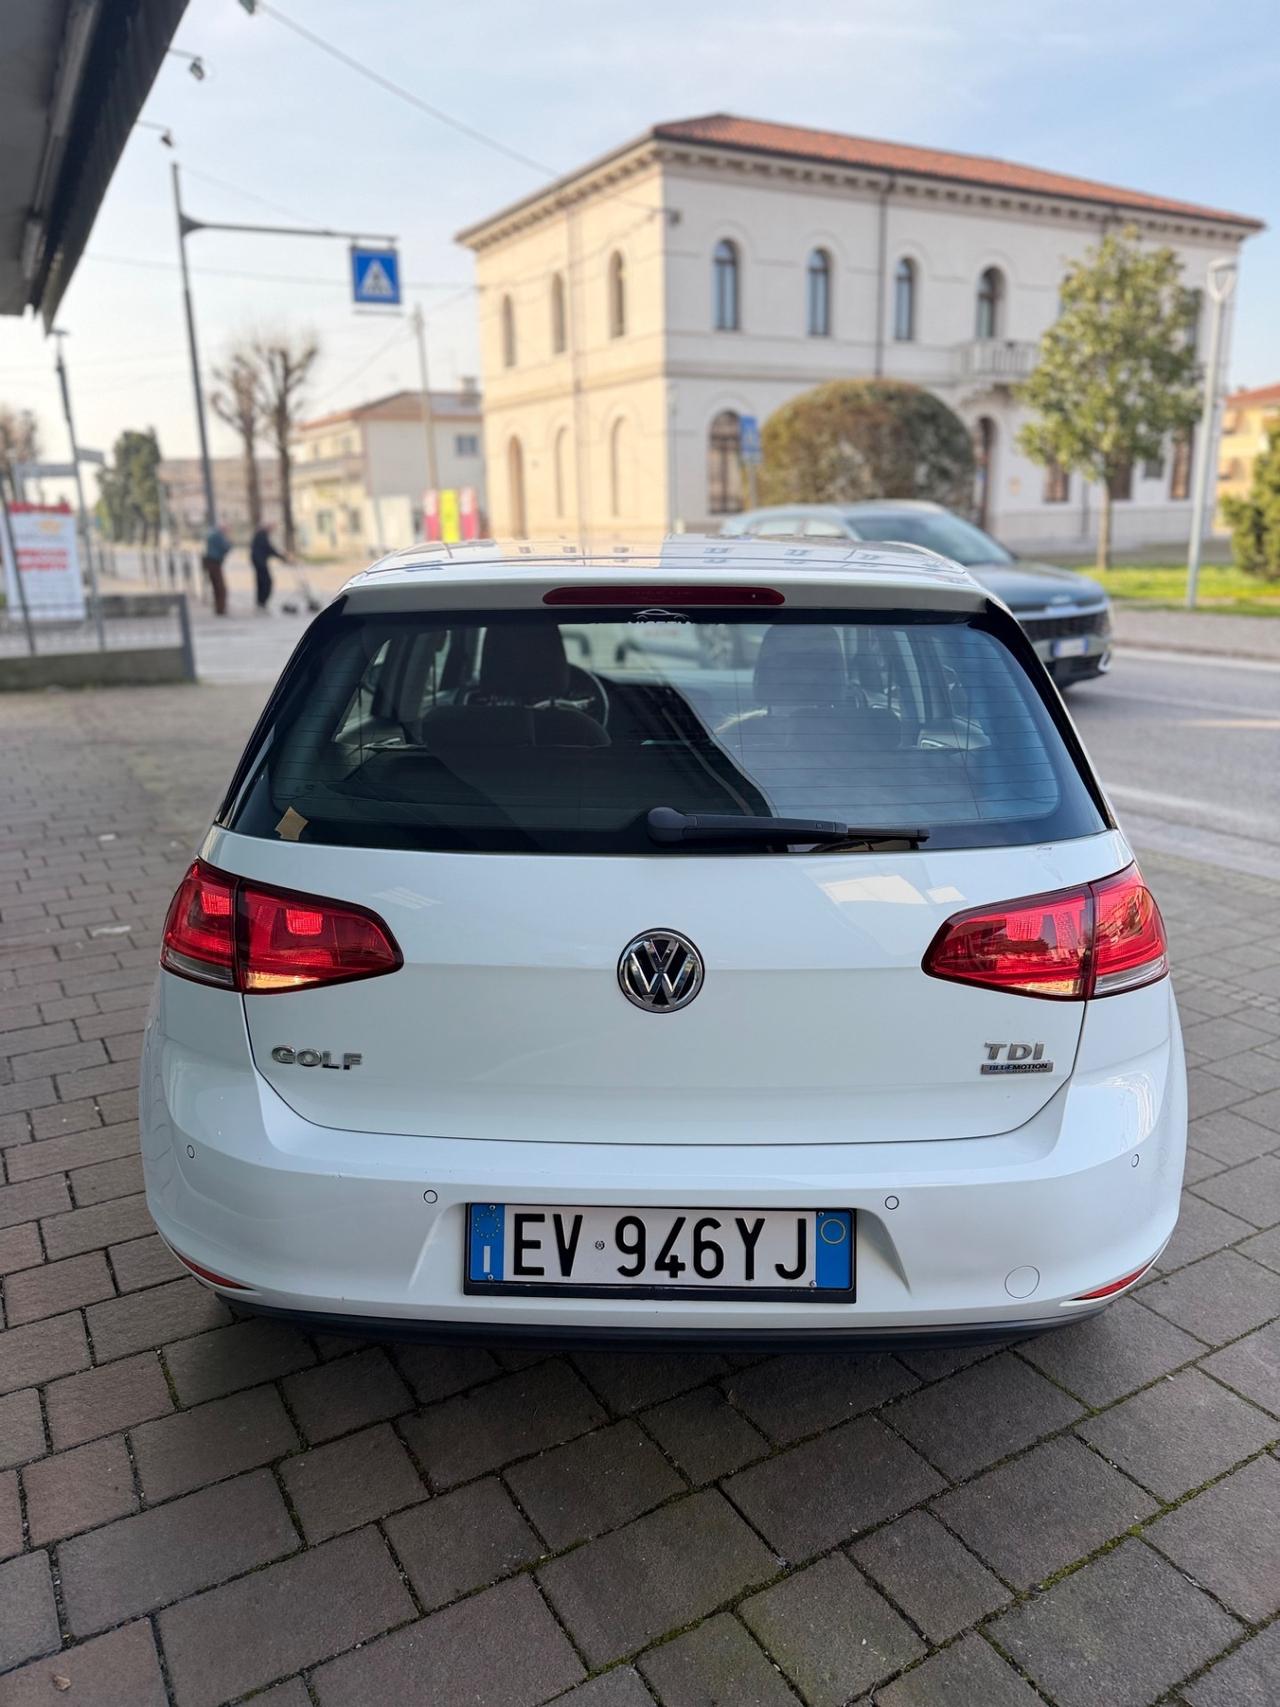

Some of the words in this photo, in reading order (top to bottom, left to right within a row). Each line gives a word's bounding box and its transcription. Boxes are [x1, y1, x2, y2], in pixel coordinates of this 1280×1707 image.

[271, 1045, 362, 1070] GOLF
[984, 1042, 1045, 1061] TDI
[513, 1213, 583, 1277] EV
[614, 1215, 807, 1281] 946YJ
